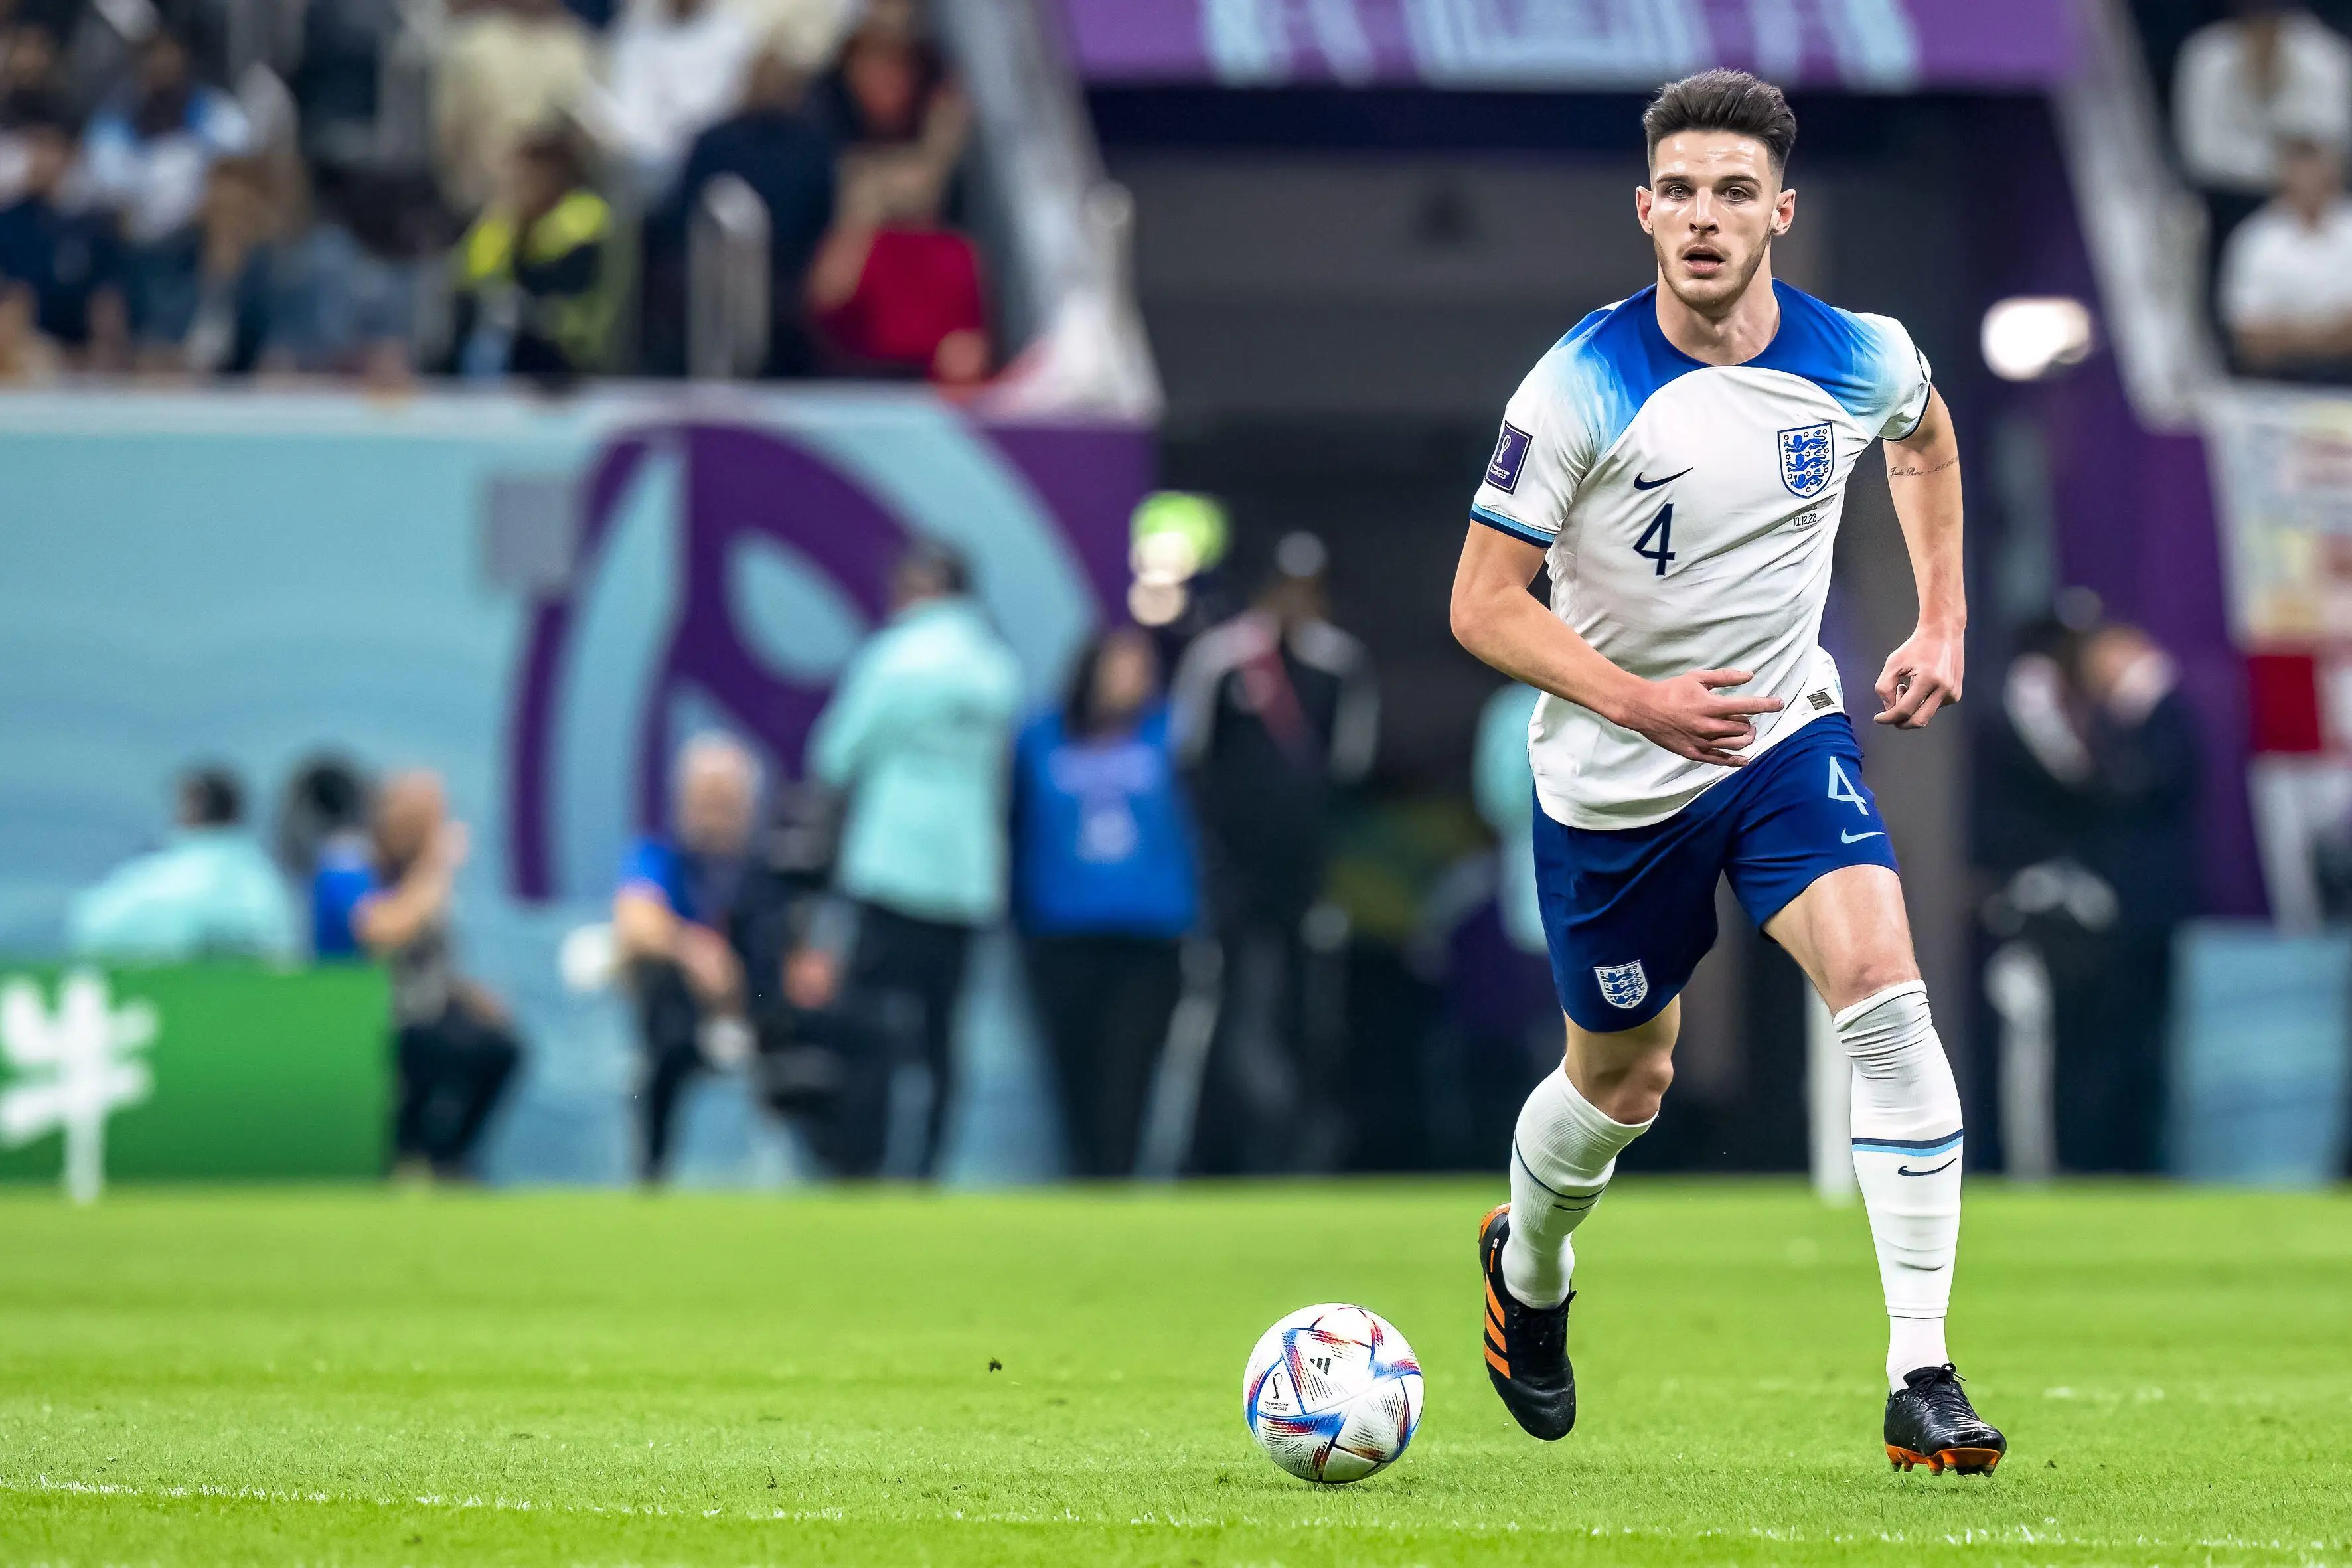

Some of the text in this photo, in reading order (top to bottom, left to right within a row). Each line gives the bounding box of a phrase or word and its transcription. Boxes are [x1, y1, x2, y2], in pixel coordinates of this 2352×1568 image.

[1632, 503, 1676, 576] 4
[1793, 512, 1817, 526] 10.12.22
[1828, 755, 1869, 815] 4
